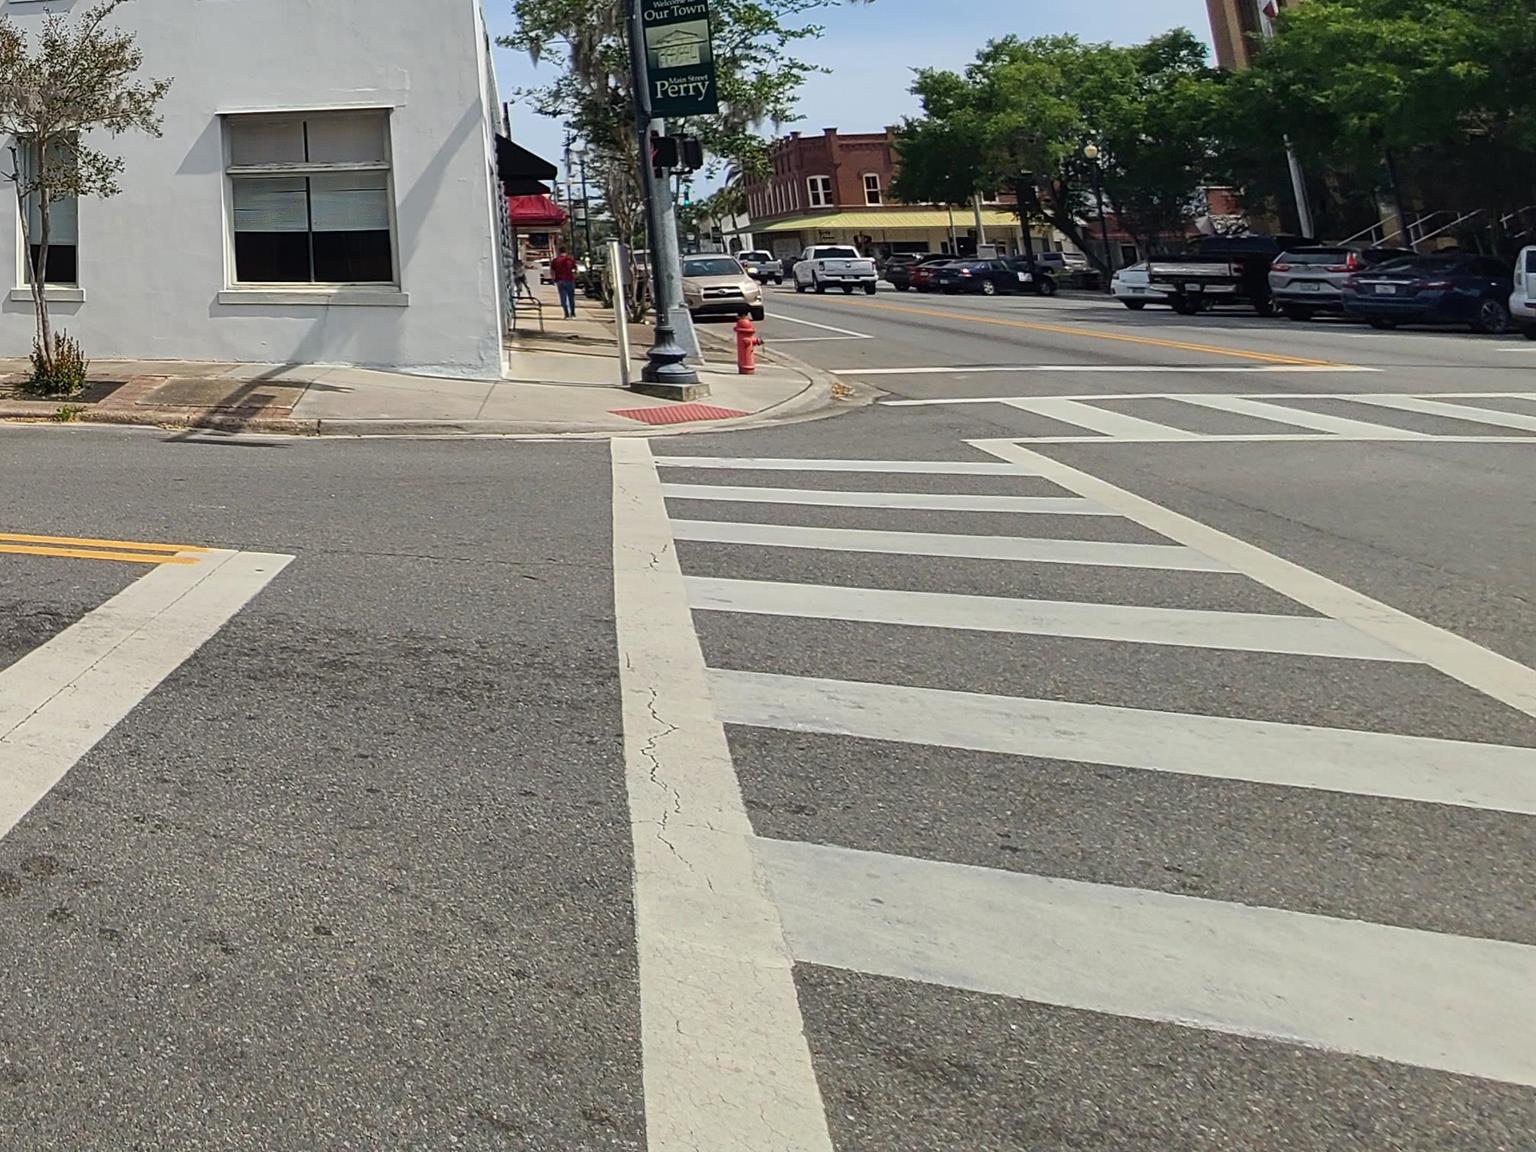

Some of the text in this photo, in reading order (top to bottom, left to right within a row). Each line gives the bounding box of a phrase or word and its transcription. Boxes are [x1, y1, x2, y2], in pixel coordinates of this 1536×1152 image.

[643, 4, 706, 21] Our Town
[655, 80, 710, 101] Perry
